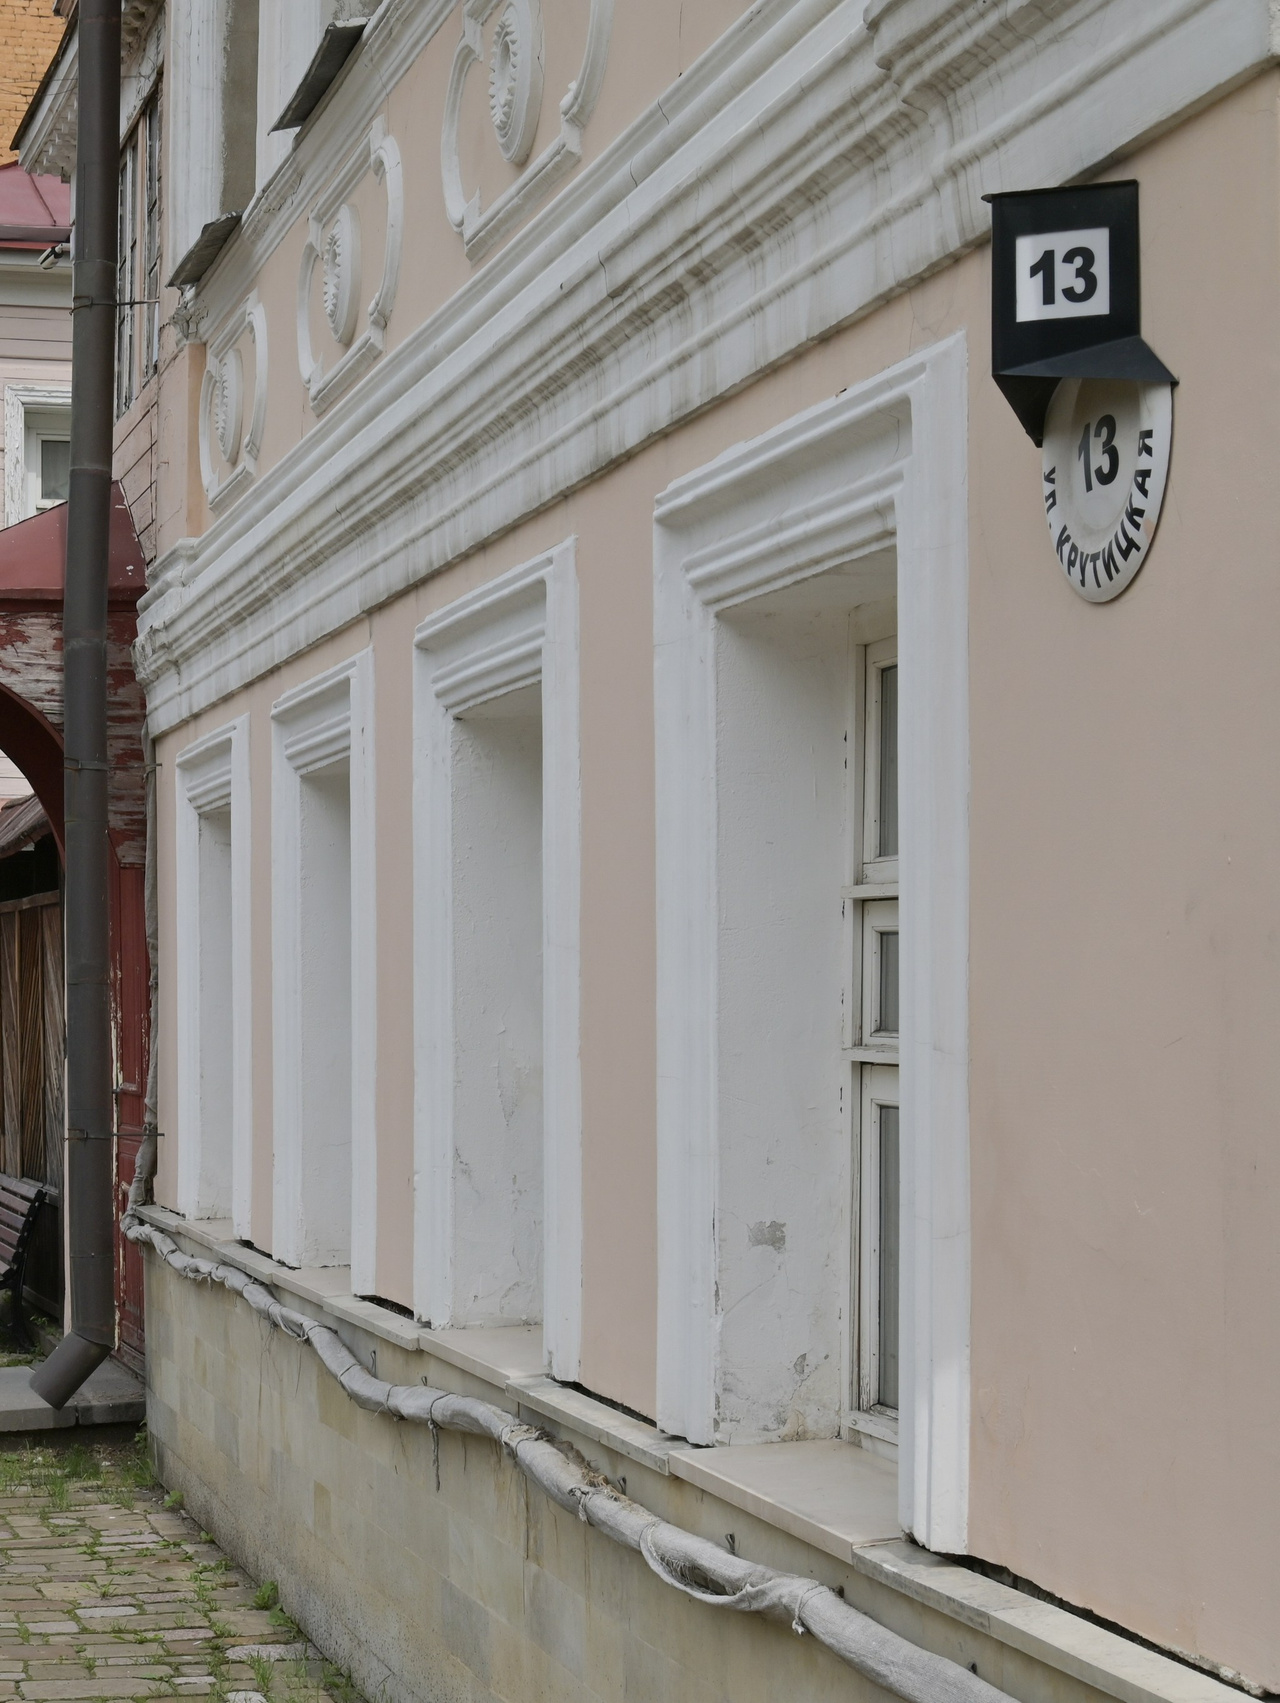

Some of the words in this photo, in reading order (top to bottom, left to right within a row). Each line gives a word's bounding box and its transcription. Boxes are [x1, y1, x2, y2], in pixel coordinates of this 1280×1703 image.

[1029, 247, 1098, 305] 13
[1078, 414, 1119, 493] 13
[1056, 429, 1153, 588] КРУТИЦКАЯ
